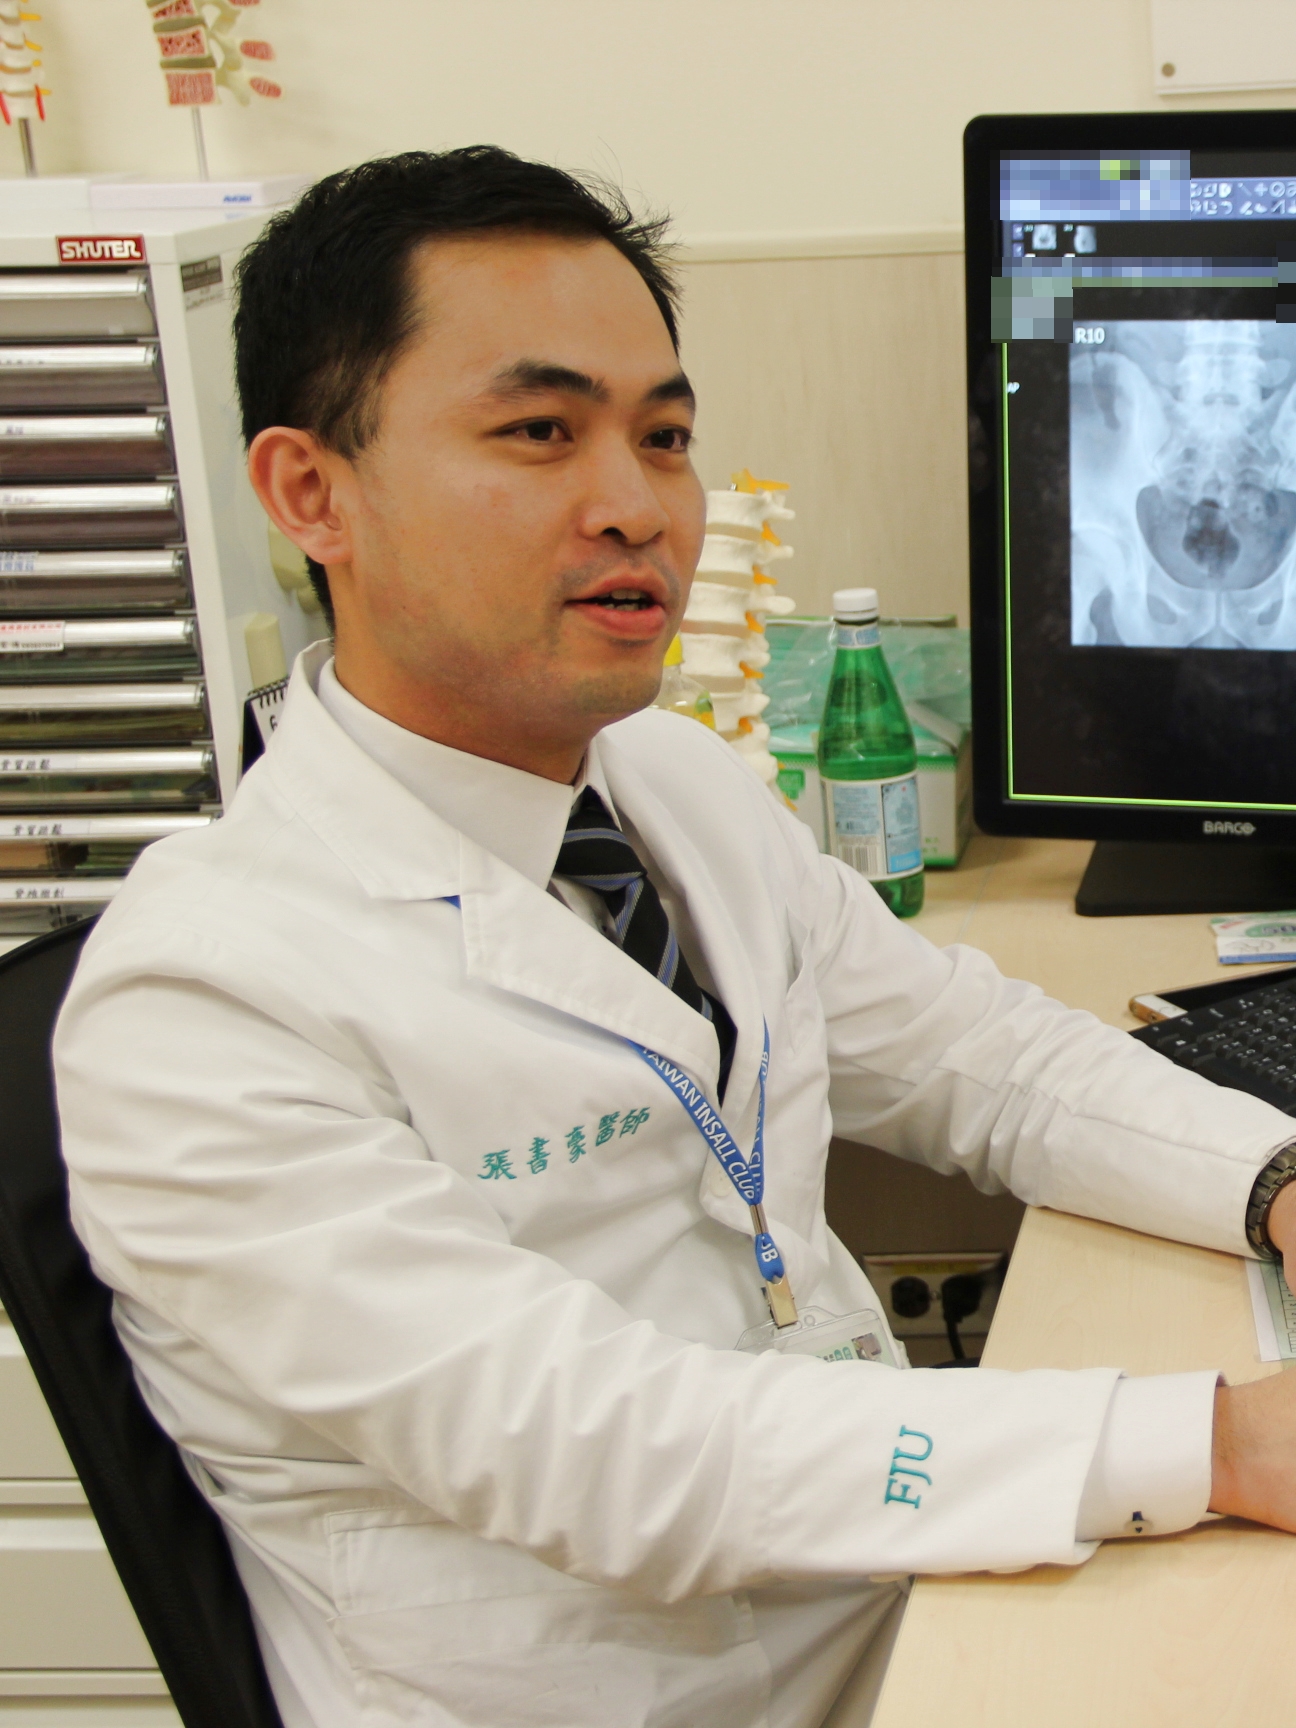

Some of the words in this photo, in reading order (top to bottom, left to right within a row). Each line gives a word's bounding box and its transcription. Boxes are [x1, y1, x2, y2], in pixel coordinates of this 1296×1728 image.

[61, 240, 141, 260] SHUTER
[1074, 327, 1106, 344] R10
[1203, 820, 1256, 836] BARCO
[477, 1106, 651, 1181] 張書豪醫師
[693, 1101, 737, 1163] INSALL
[883, 1424, 934, 1510] FJU
